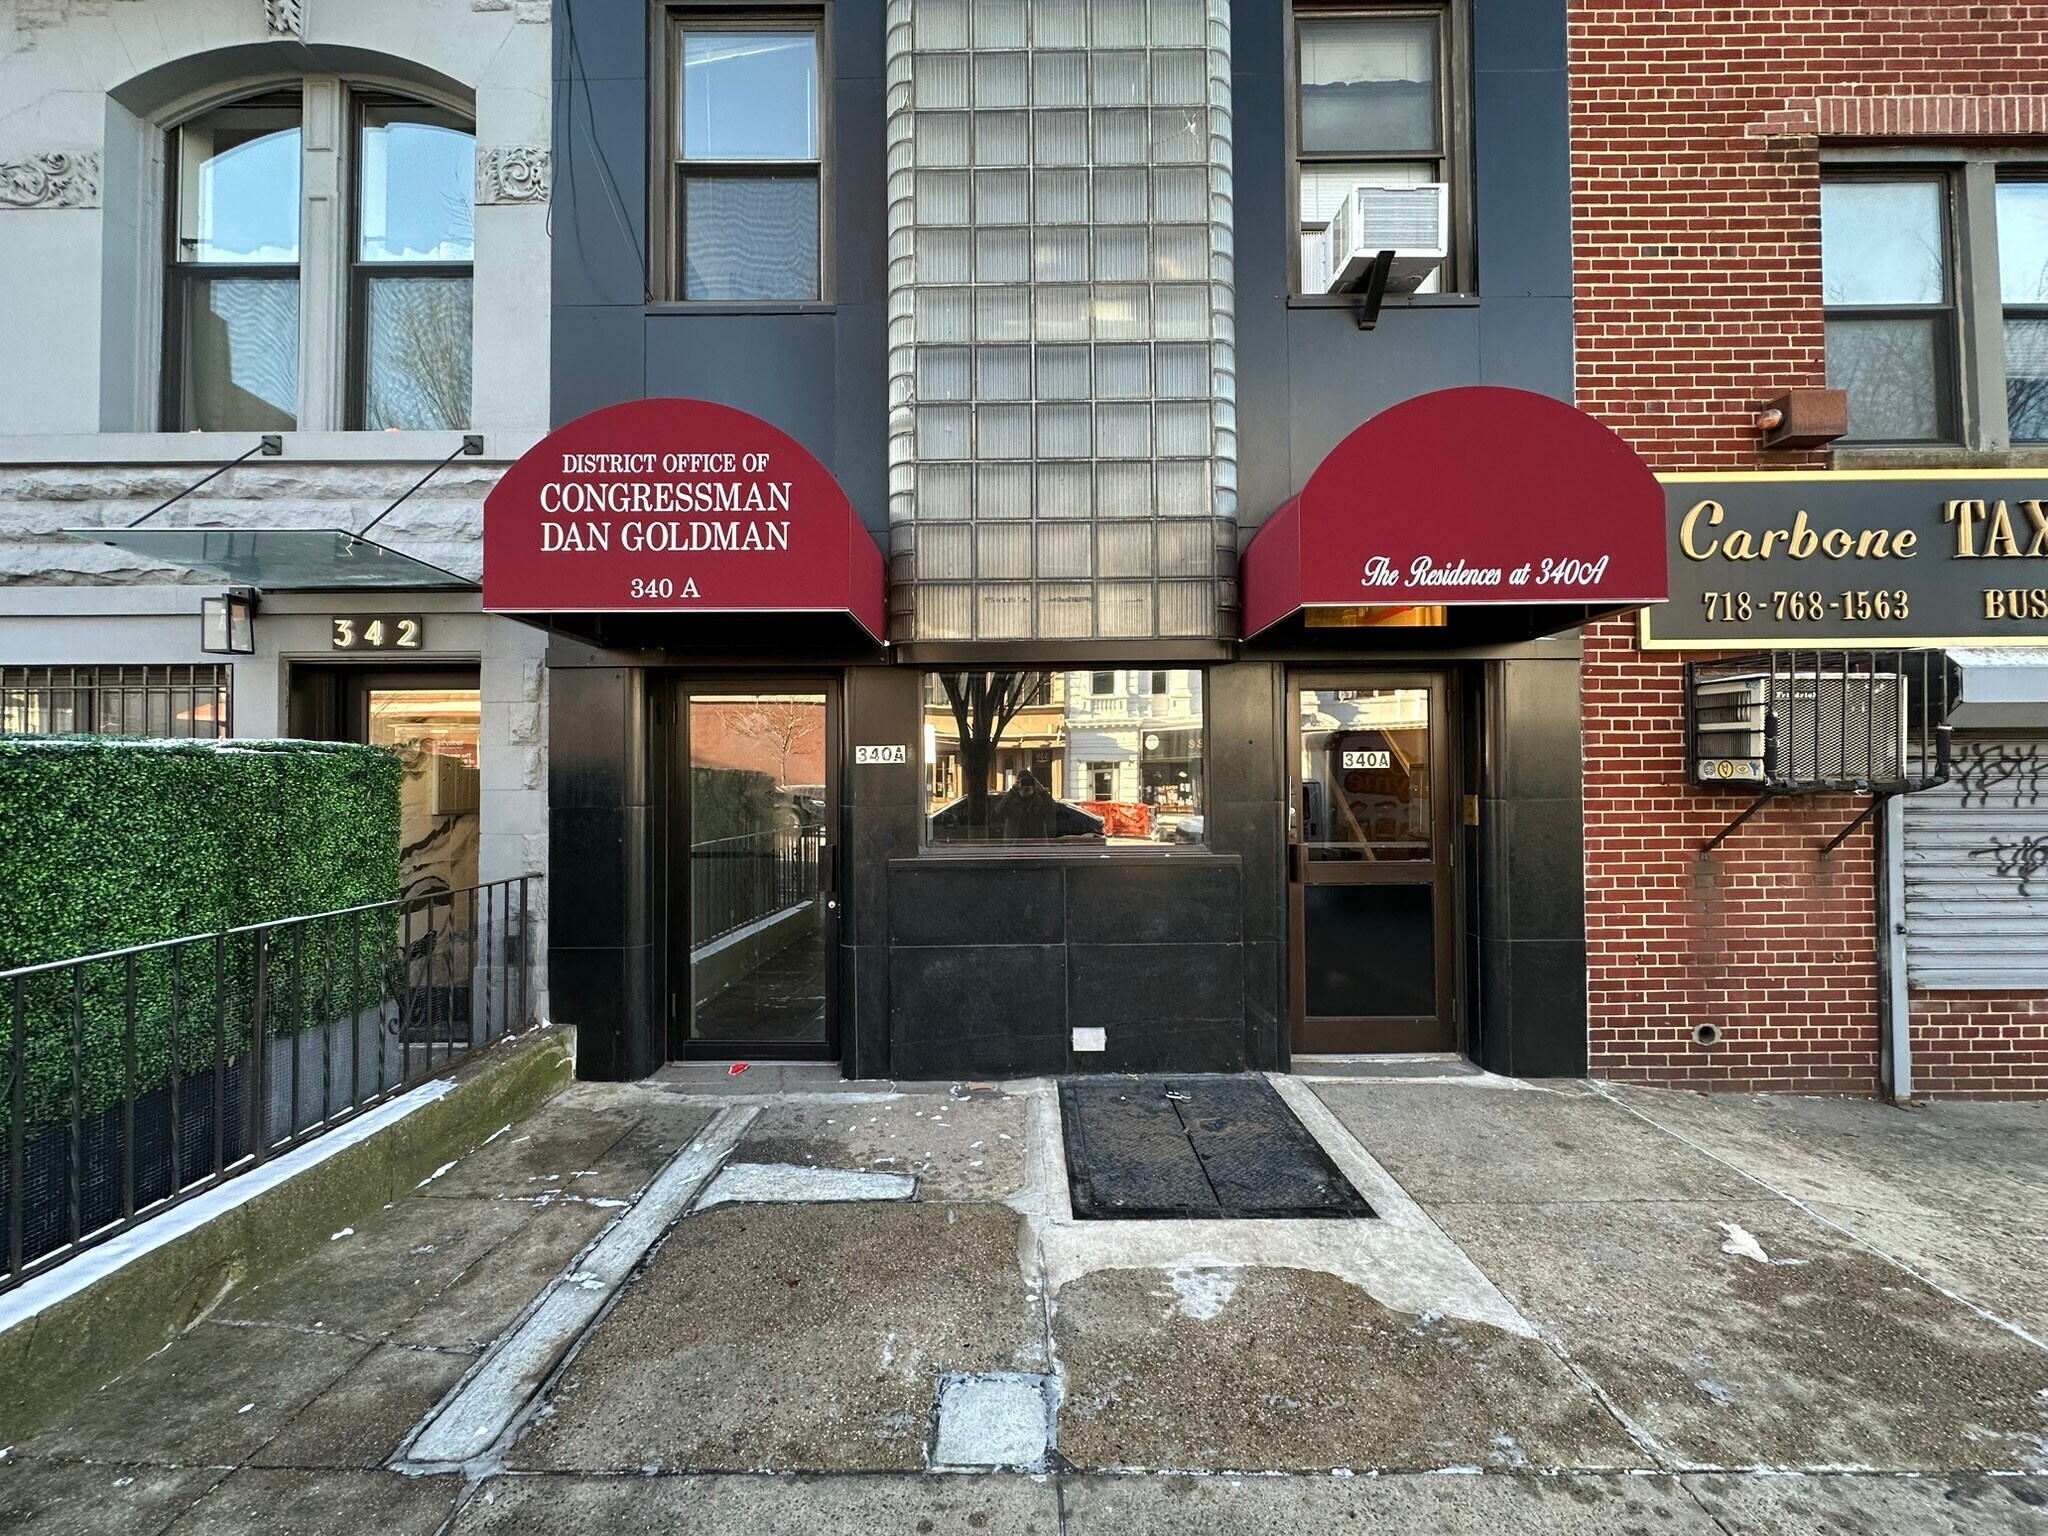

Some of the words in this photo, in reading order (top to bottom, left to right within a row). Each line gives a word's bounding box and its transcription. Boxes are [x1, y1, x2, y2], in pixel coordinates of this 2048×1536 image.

[563, 454, 656, 473] DISTRICT
[663, 454, 735, 473] OFFICE
[743, 454, 769, 472] OF
[541, 482, 792, 512] CONGRESSMAN
[541, 522, 611, 551] DAN
[622, 521, 790, 551] GOLDMAN
[1679, 499, 1918, 561] Carbone
[1944, 499, 2048, 560] TAX
[1362, 557, 1399, 586] The
[1404, 556, 1501, 587] Residences
[1509, 563, 1531, 585] at
[1536, 555, 1609, 585] 340A
[631, 579, 672, 598] 340
[681, 577, 700, 597] A
[1703, 590, 1910, 621] 718-768-1563
[1983, 588, 2048, 619] BUS
[333, 619, 416, 647] 342
[1775, 690, 1817, 699] Fridric
[859, 747, 903, 761] 340A
[1346, 753, 1388, 766] 340A
